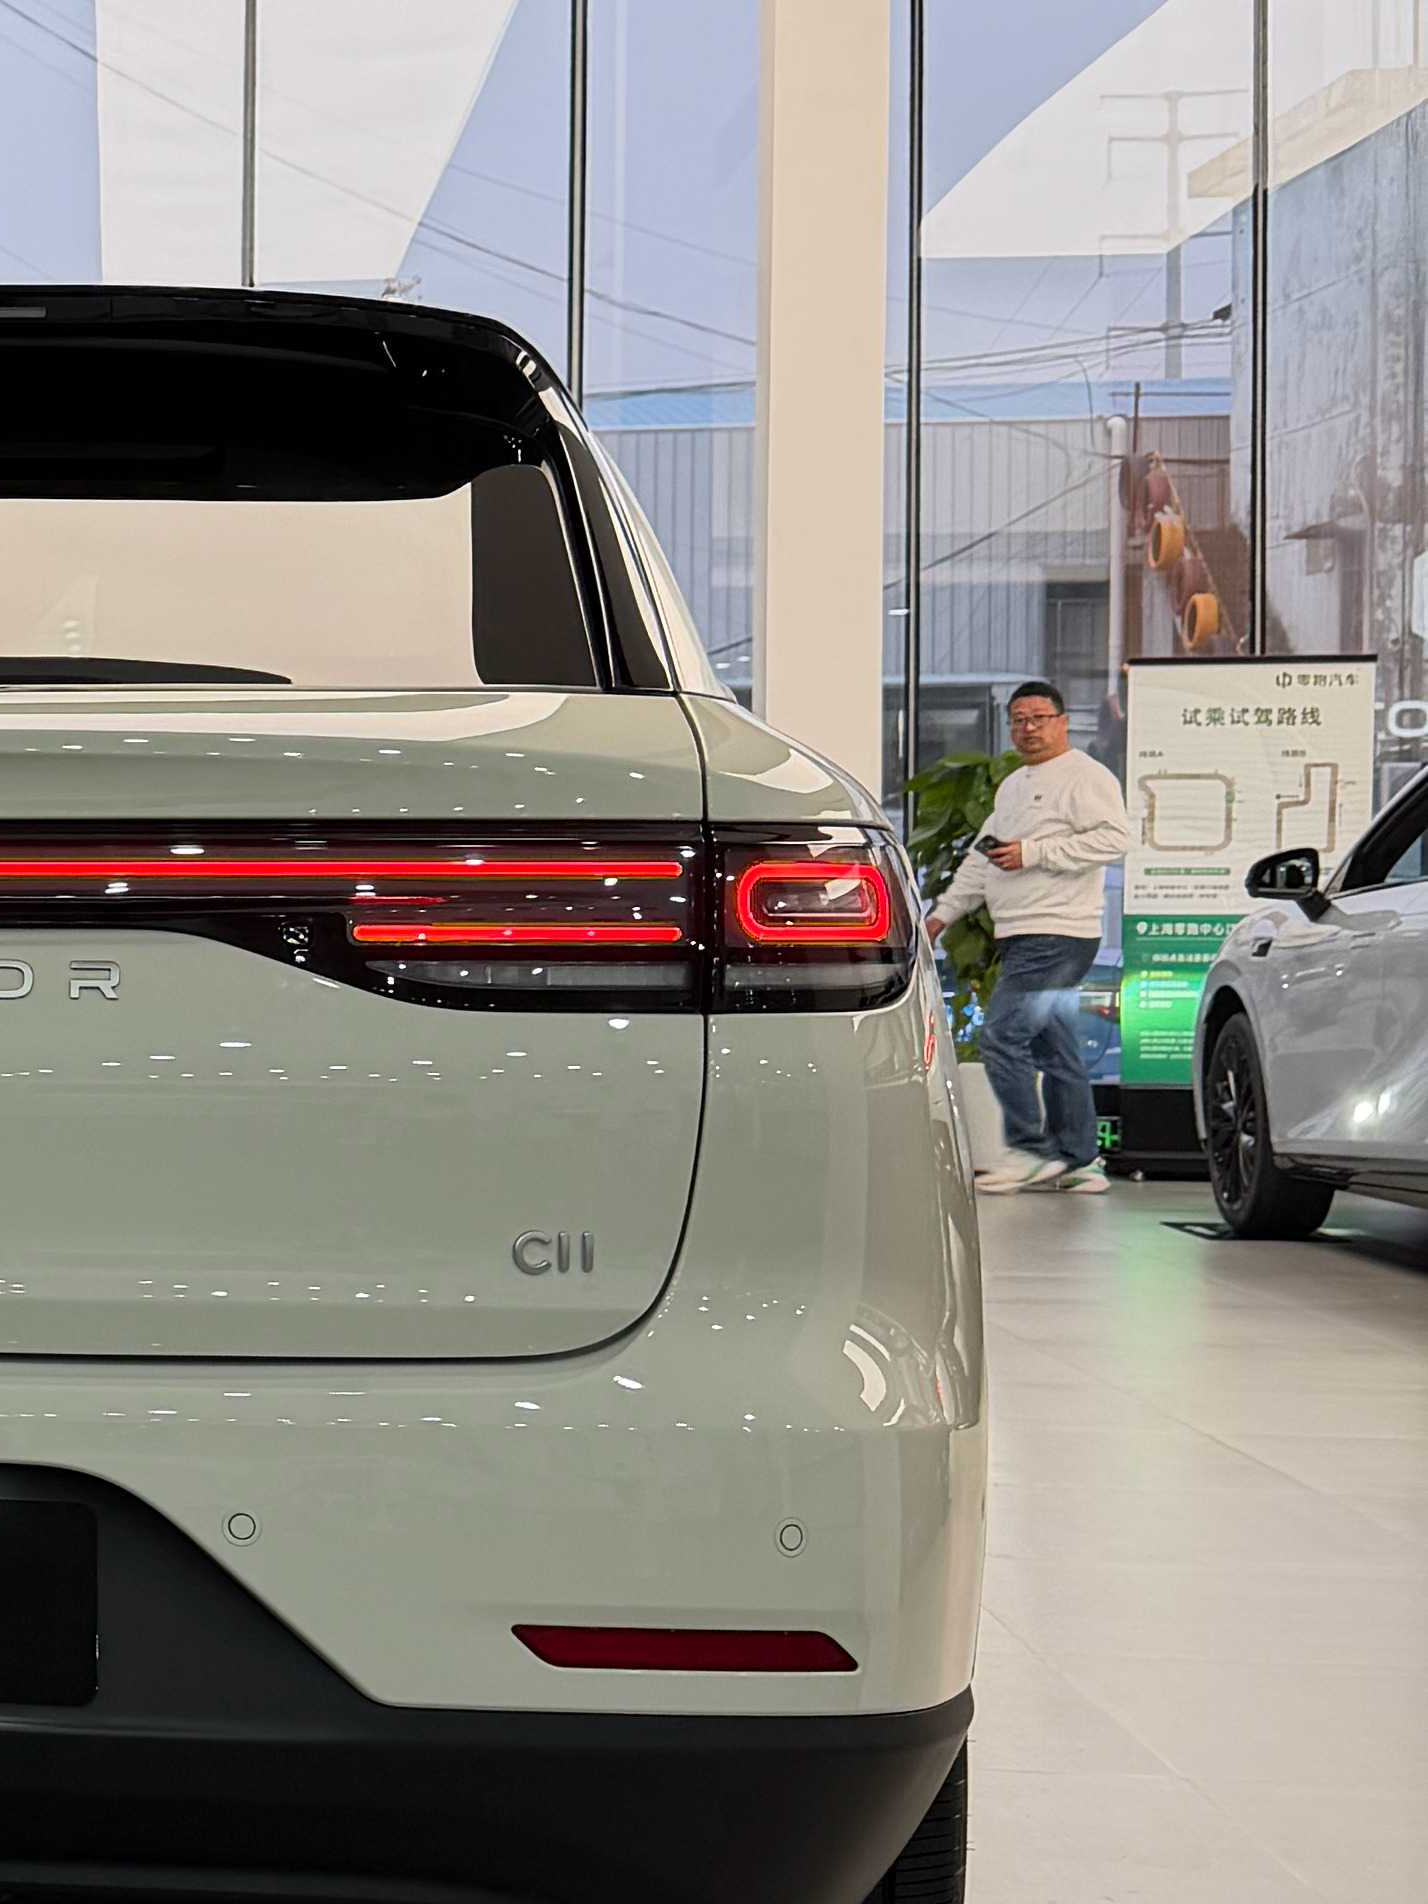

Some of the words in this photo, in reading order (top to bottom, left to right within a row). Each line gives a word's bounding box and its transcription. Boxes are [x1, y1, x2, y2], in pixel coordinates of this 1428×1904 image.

[1181, 706, 1323, 728] 试乘试驾路线
